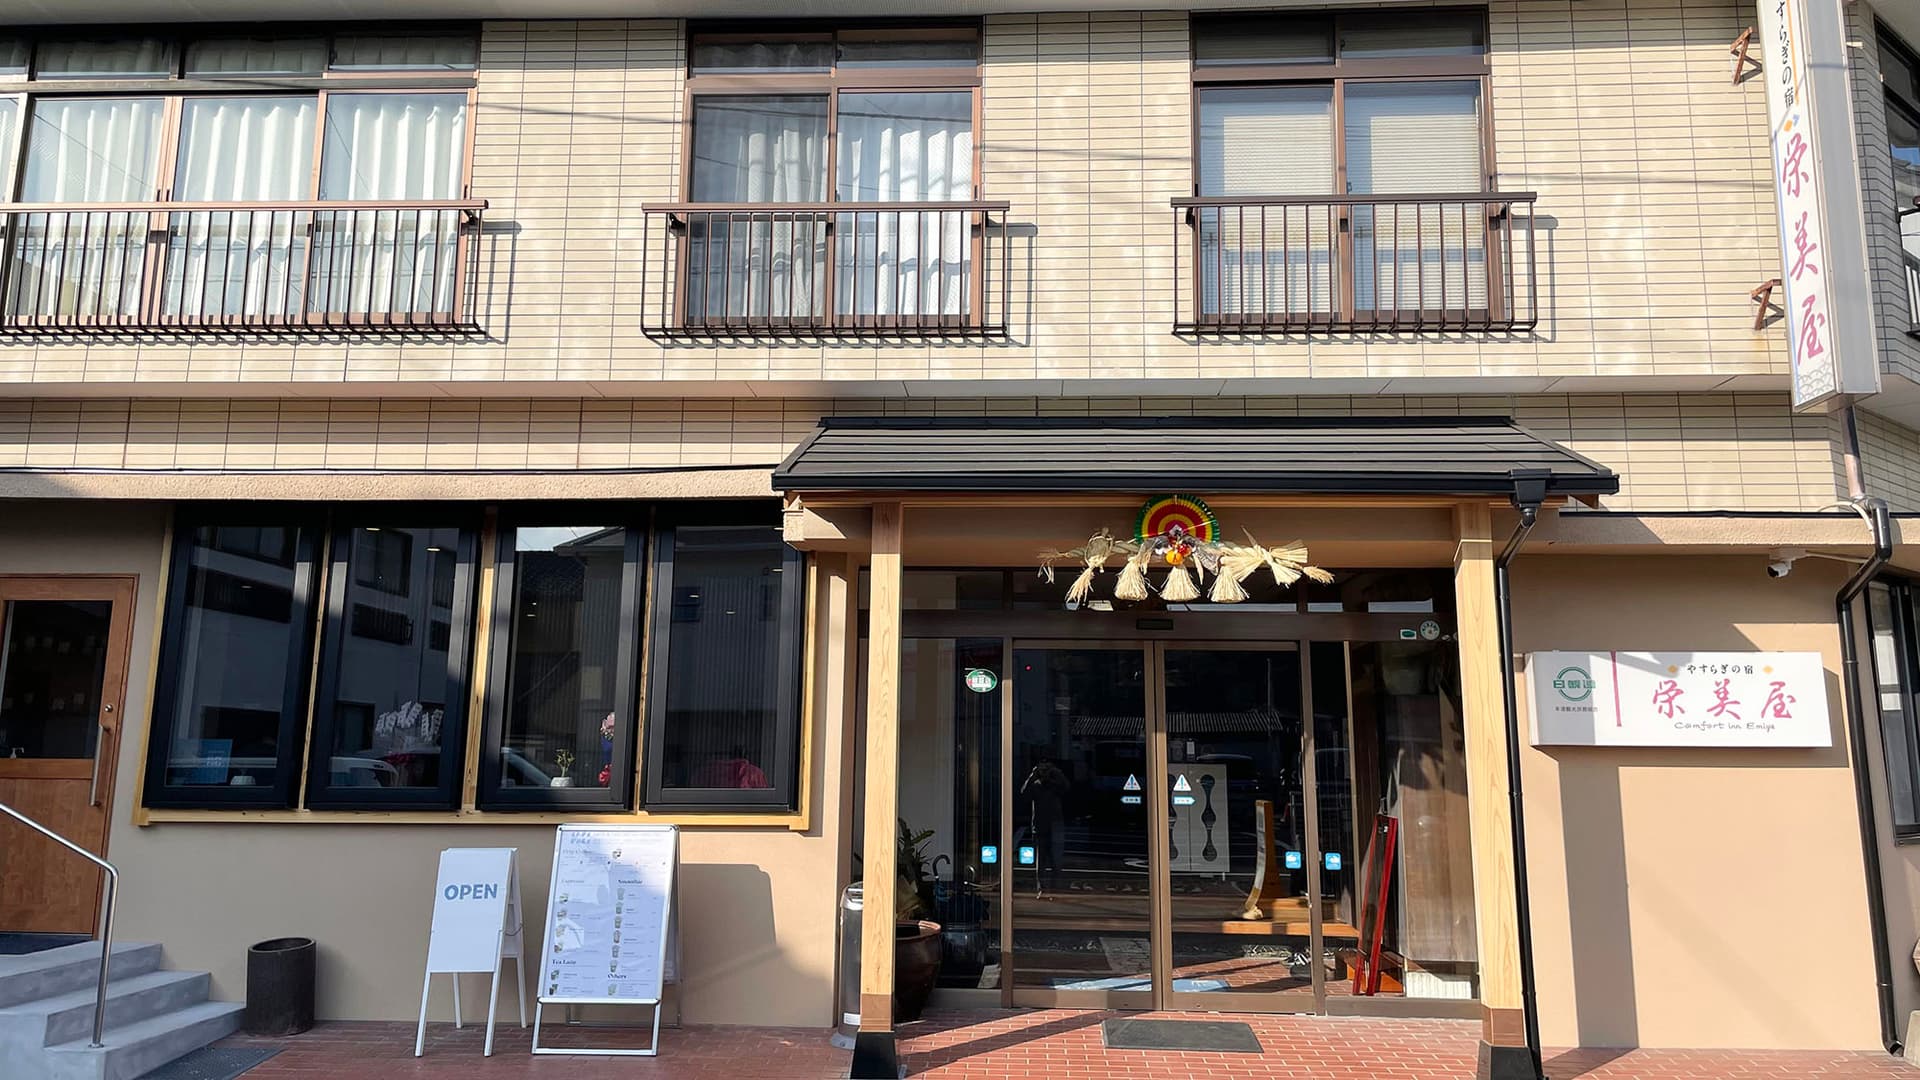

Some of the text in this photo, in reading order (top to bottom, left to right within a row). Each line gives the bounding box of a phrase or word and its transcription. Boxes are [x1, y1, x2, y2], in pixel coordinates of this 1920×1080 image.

[1782, 131, 1826, 366] 栄美屋
[1687, 664, 1753, 675] やすらぎの宿
[1652, 678, 1797, 721] 栄美屋
[1674, 721, 1725, 732] Comfort
[444, 883, 498, 900] OPEN
